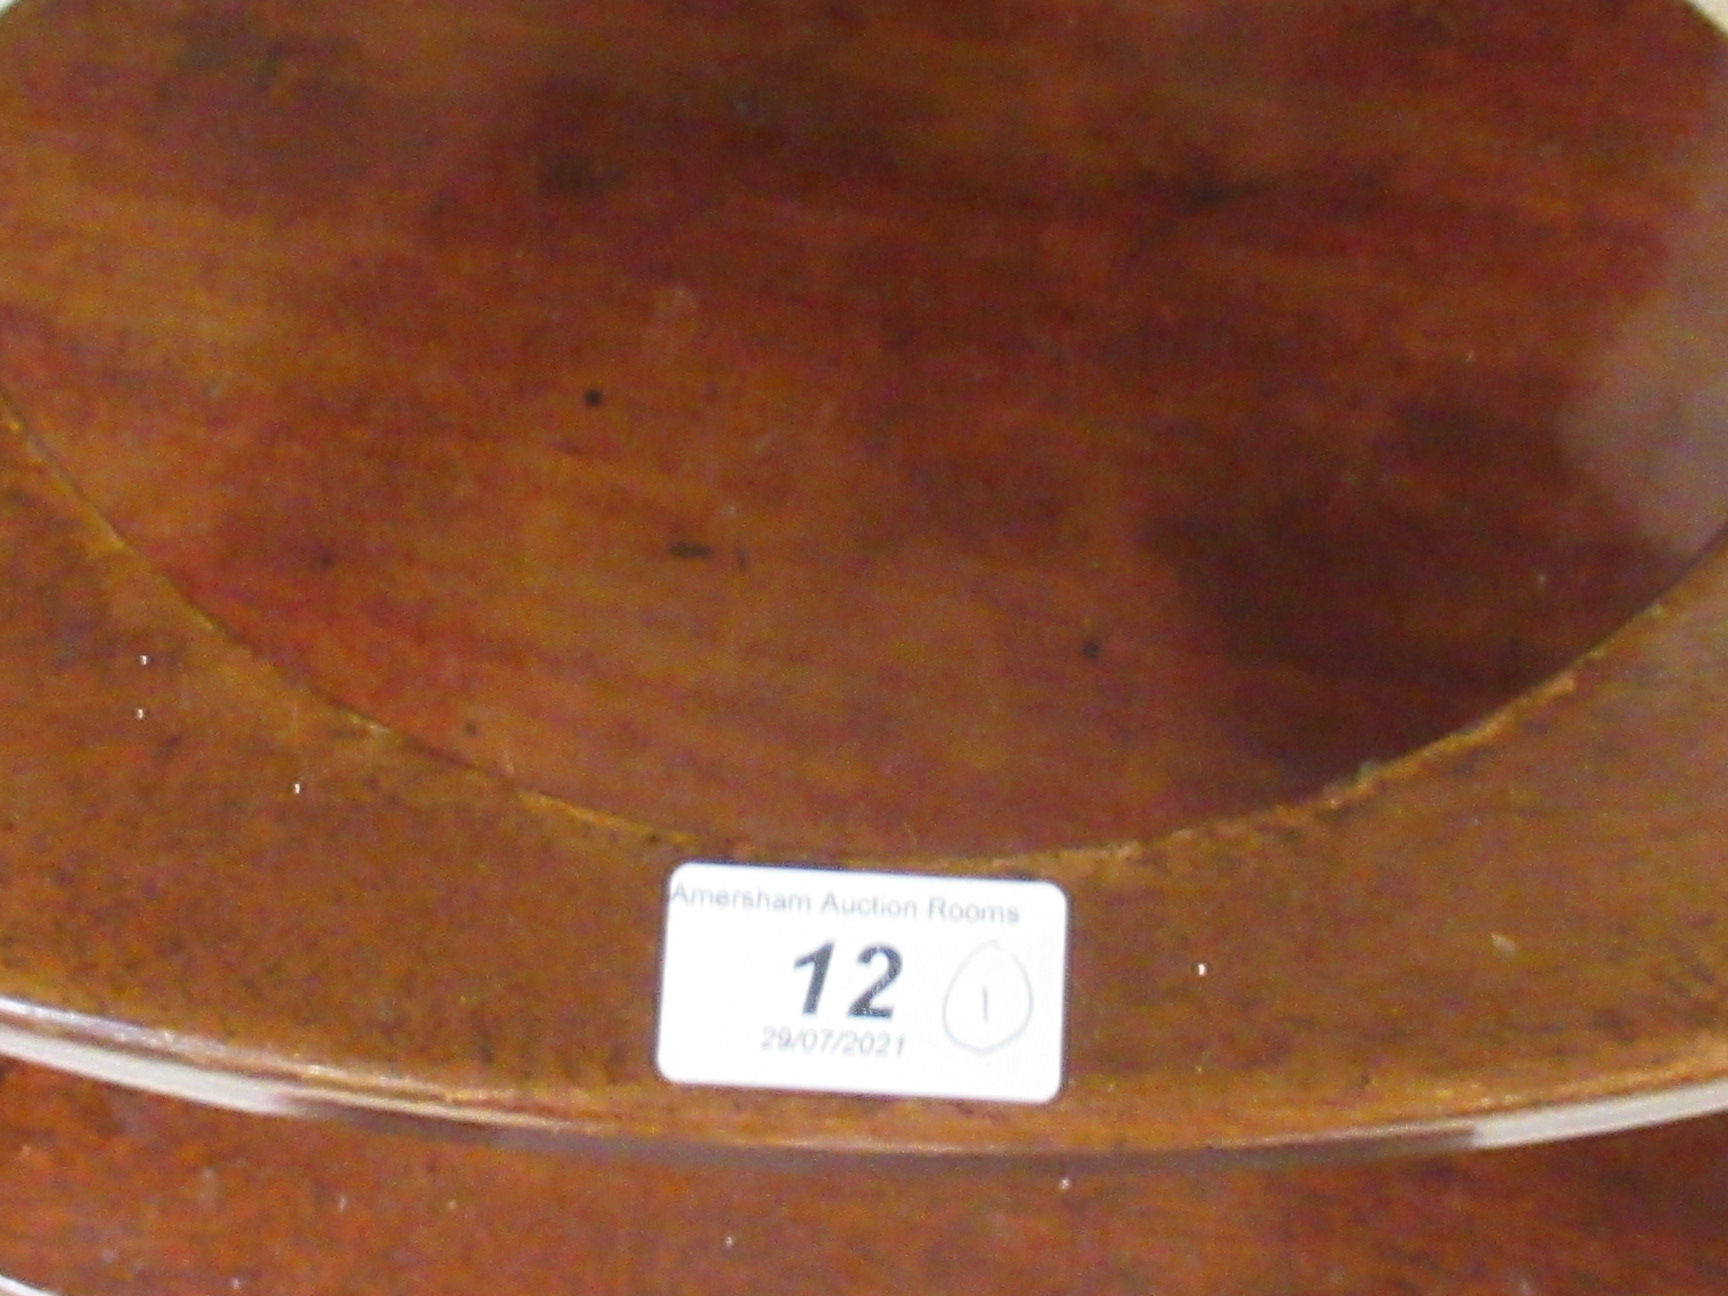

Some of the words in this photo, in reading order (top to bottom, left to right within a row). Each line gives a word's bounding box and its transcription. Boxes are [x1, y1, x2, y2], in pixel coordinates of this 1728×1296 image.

[670, 882, 811, 914] Amersham
[821, 893, 918, 919] Auction
[927, 896, 1020, 924] Rooms
[793, 940, 904, 1020] 12
[760, 1026, 906, 1059] 29/07/2021
